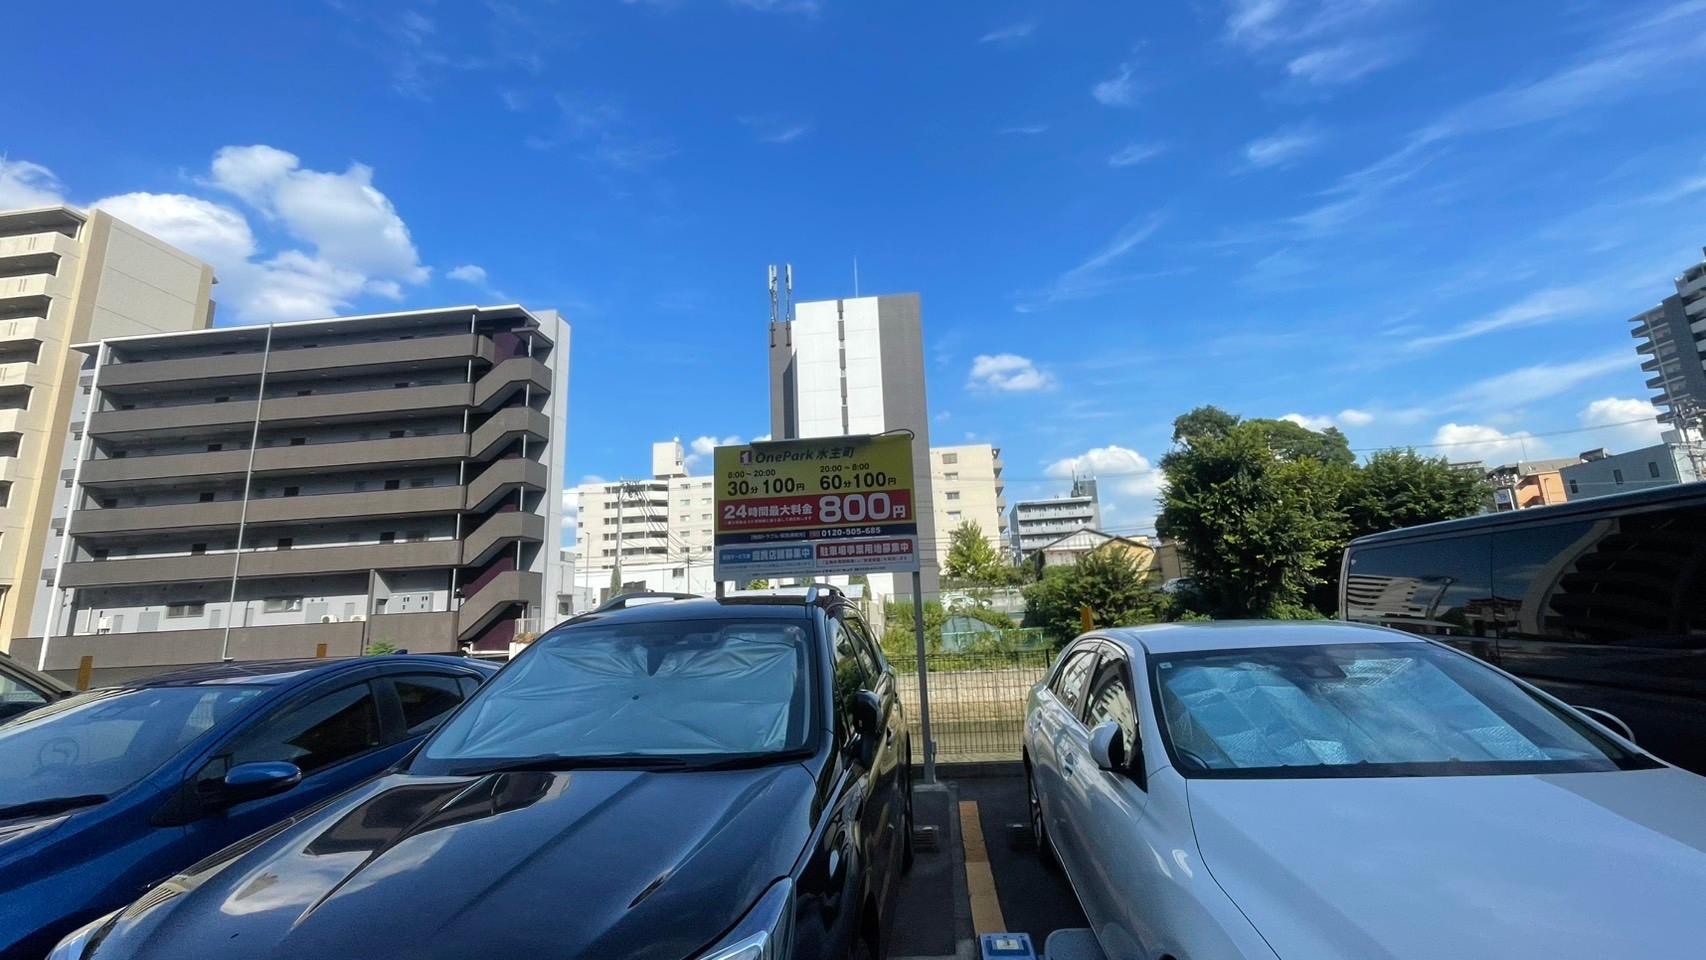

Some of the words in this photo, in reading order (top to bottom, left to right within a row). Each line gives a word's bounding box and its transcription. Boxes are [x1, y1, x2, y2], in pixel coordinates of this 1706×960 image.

[755, 449, 813, 464] OnePark
[763, 477, 805, 494] 100円
[853, 472, 897, 488] 100円
[723, 503, 813, 519] 24時間最大料金
[821, 527, 881, 537] 0120-505-685
